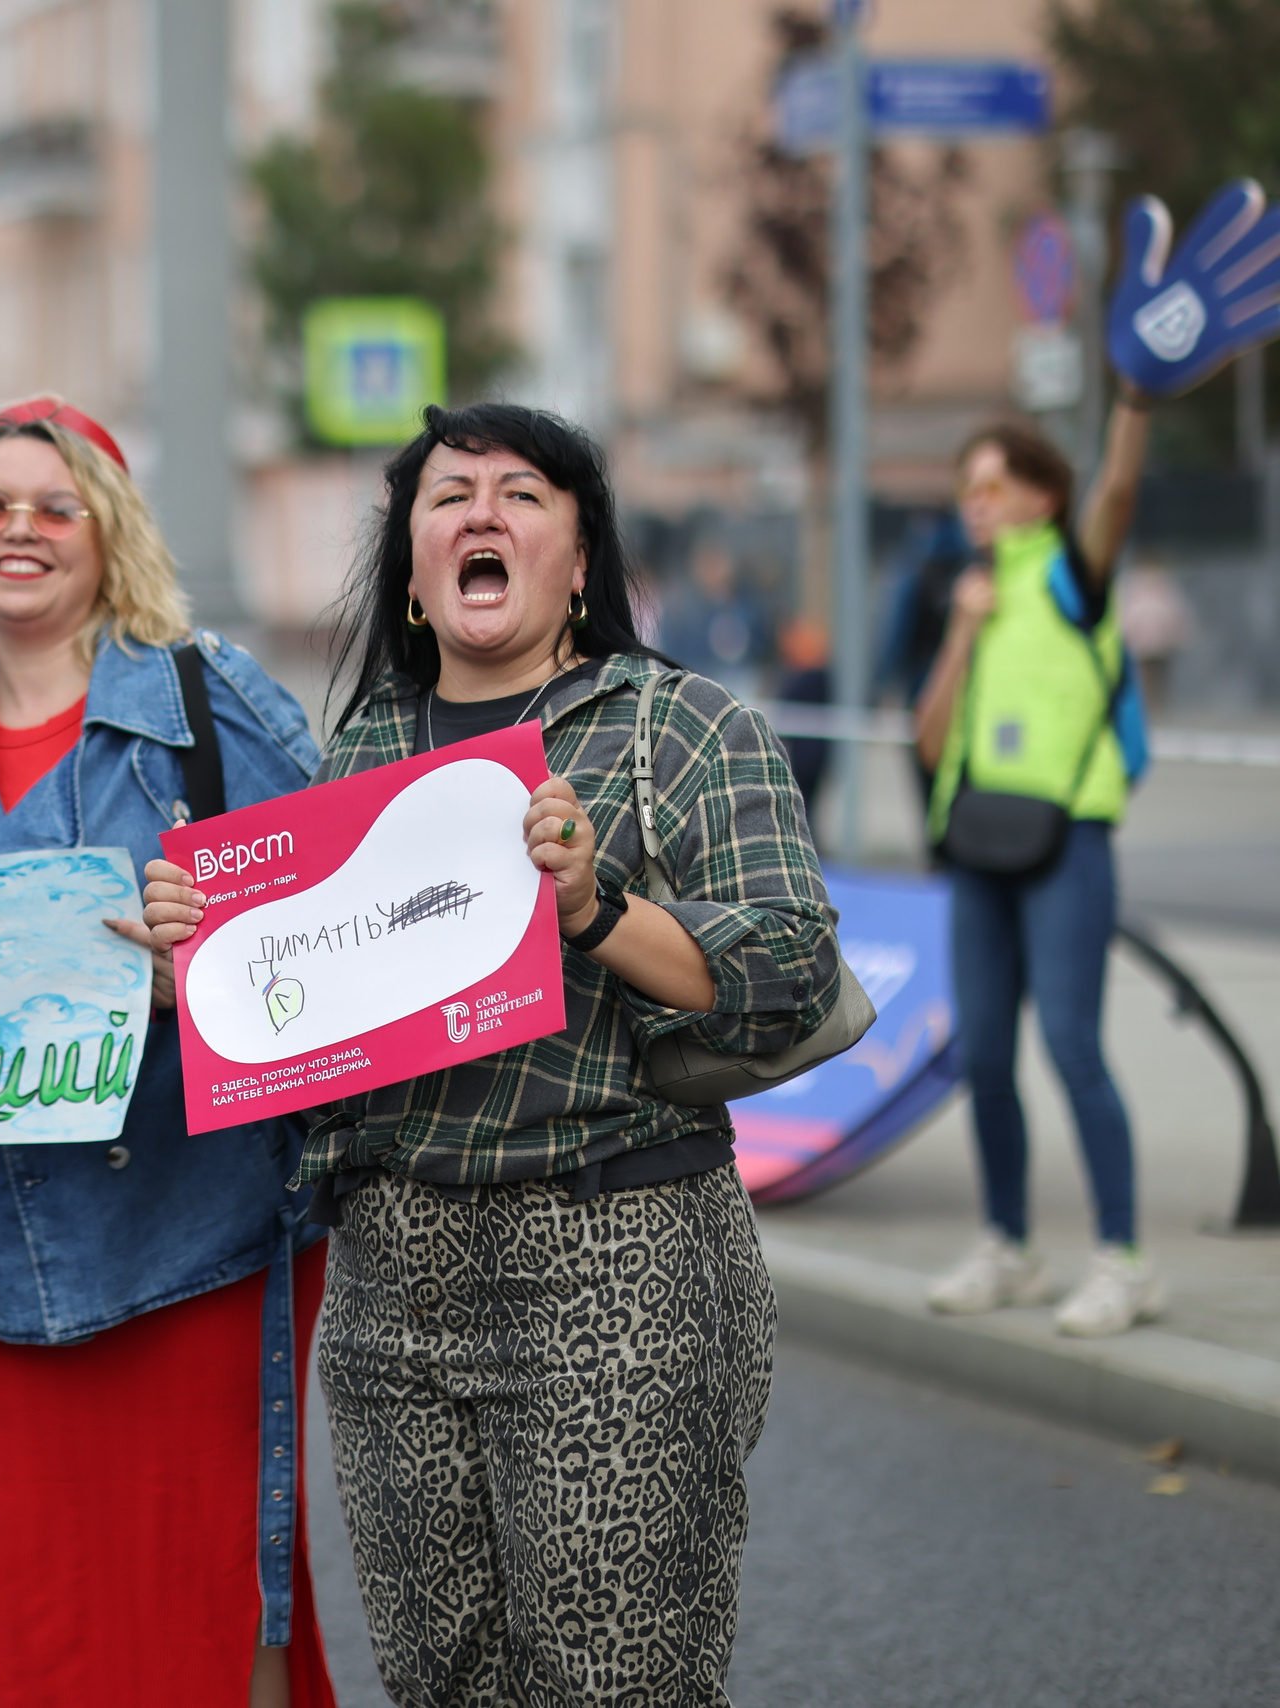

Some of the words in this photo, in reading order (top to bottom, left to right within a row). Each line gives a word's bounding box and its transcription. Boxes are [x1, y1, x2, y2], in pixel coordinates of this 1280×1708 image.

[203, 890, 238, 909] уббота
[243, 881, 267, 897] утро
[273, 872, 298, 887] парк
[475, 990, 508, 1009] СОЮЗ
[476, 987, 544, 1021] ЛЮБИТЕЛЕЙ
[476, 1017, 504, 1034] БЕГА
[211, 1084, 219, 1094] Я
[221, 1076, 260, 1092] ЗДЕСЬ,
[261, 1063, 306, 1083] ПОТОМУ
[308, 1056, 329, 1070] ЧТО
[330, 1047, 364, 1064] ЗНАЮ,
[212, 1094, 235, 1107] КАК
[236, 1087, 264, 1101] ТЕБЕ
[265, 1078, 305, 1095] ВАЖНА
[306, 1057, 372, 1085] ПОДДЕРЖКА
